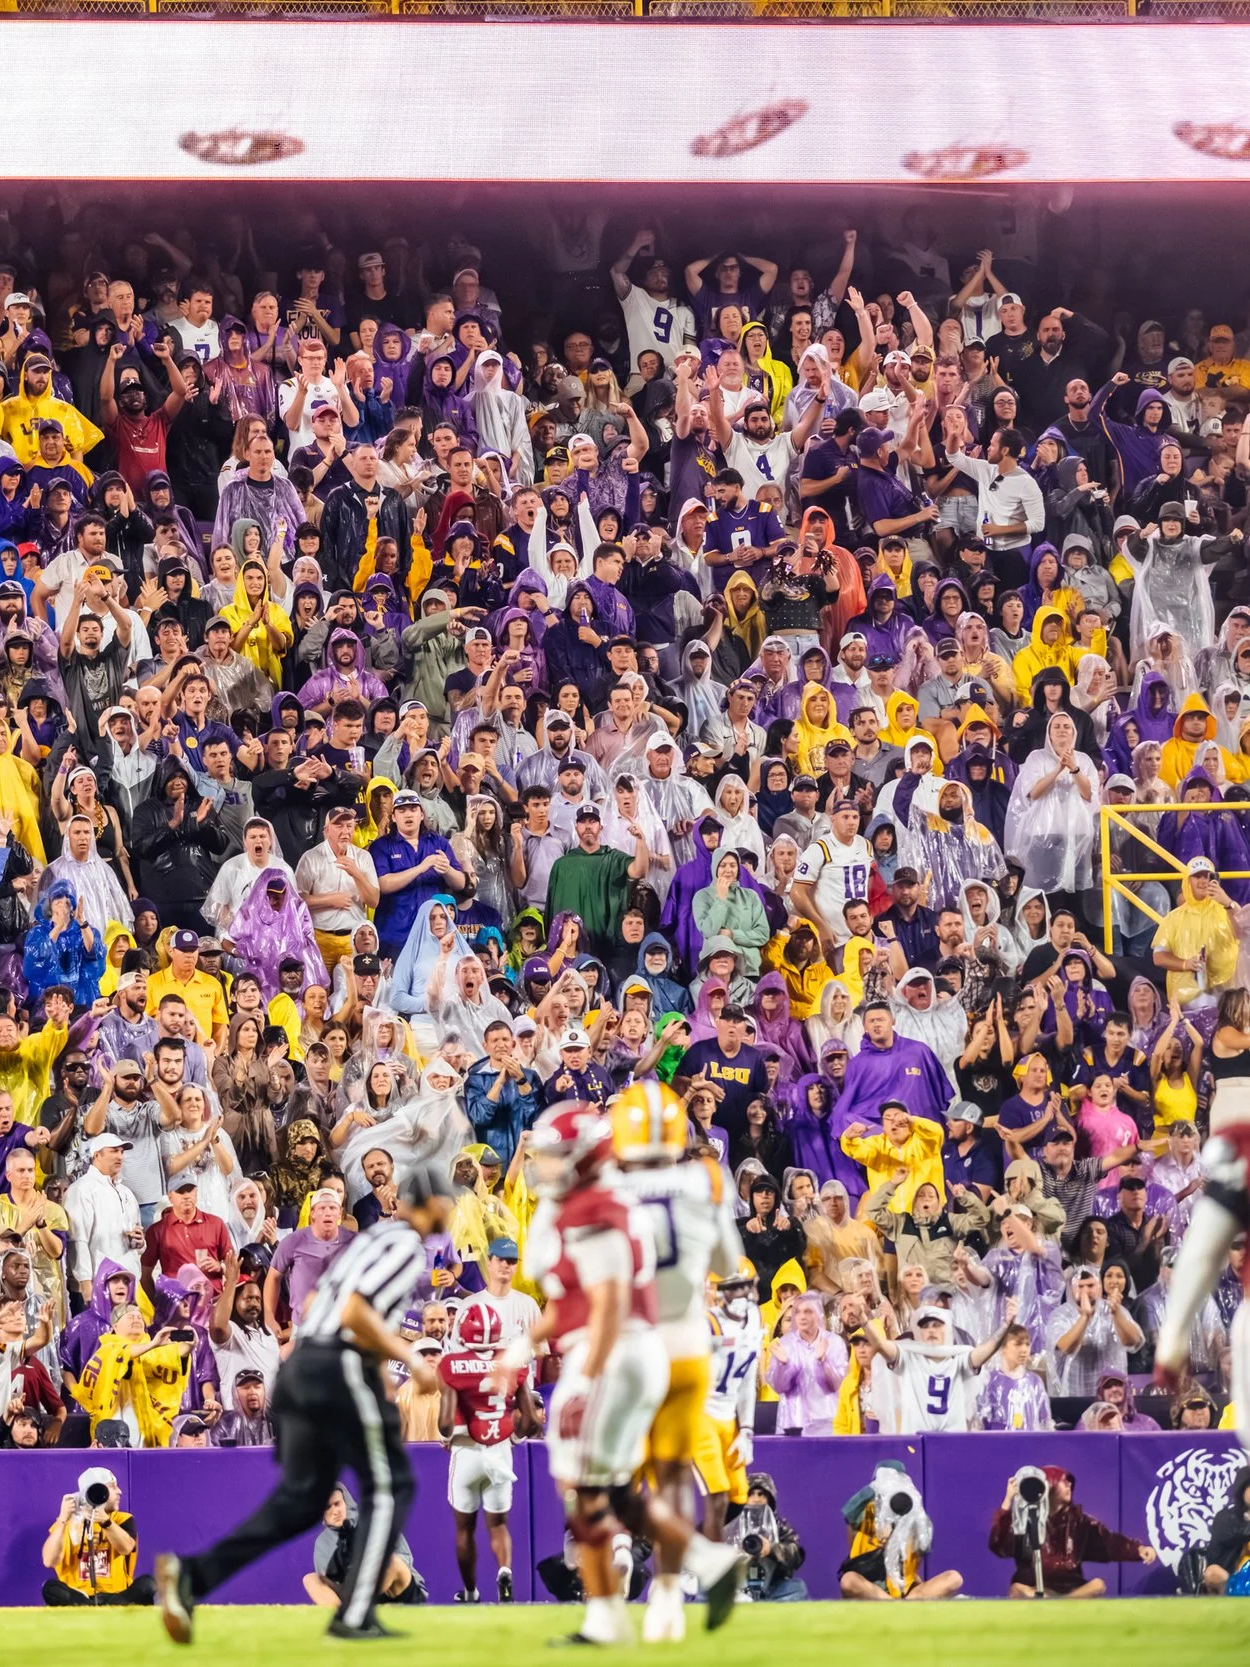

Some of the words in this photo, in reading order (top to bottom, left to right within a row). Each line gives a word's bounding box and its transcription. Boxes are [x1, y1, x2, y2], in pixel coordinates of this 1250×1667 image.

[653, 306, 673, 345] 9
[755, 453, 774, 481] 4
[843, 864, 869, 900] 18
[533, 966, 548, 975] LSU
[710, 1061, 751, 1086] LSU
[402, 1316, 420, 1328] LSU
[715, 1350, 758, 1394] 14
[476, 1374, 507, 1419] 3
[926, 1375, 951, 1415] 9
[480, 1419, 501, 1441] A
